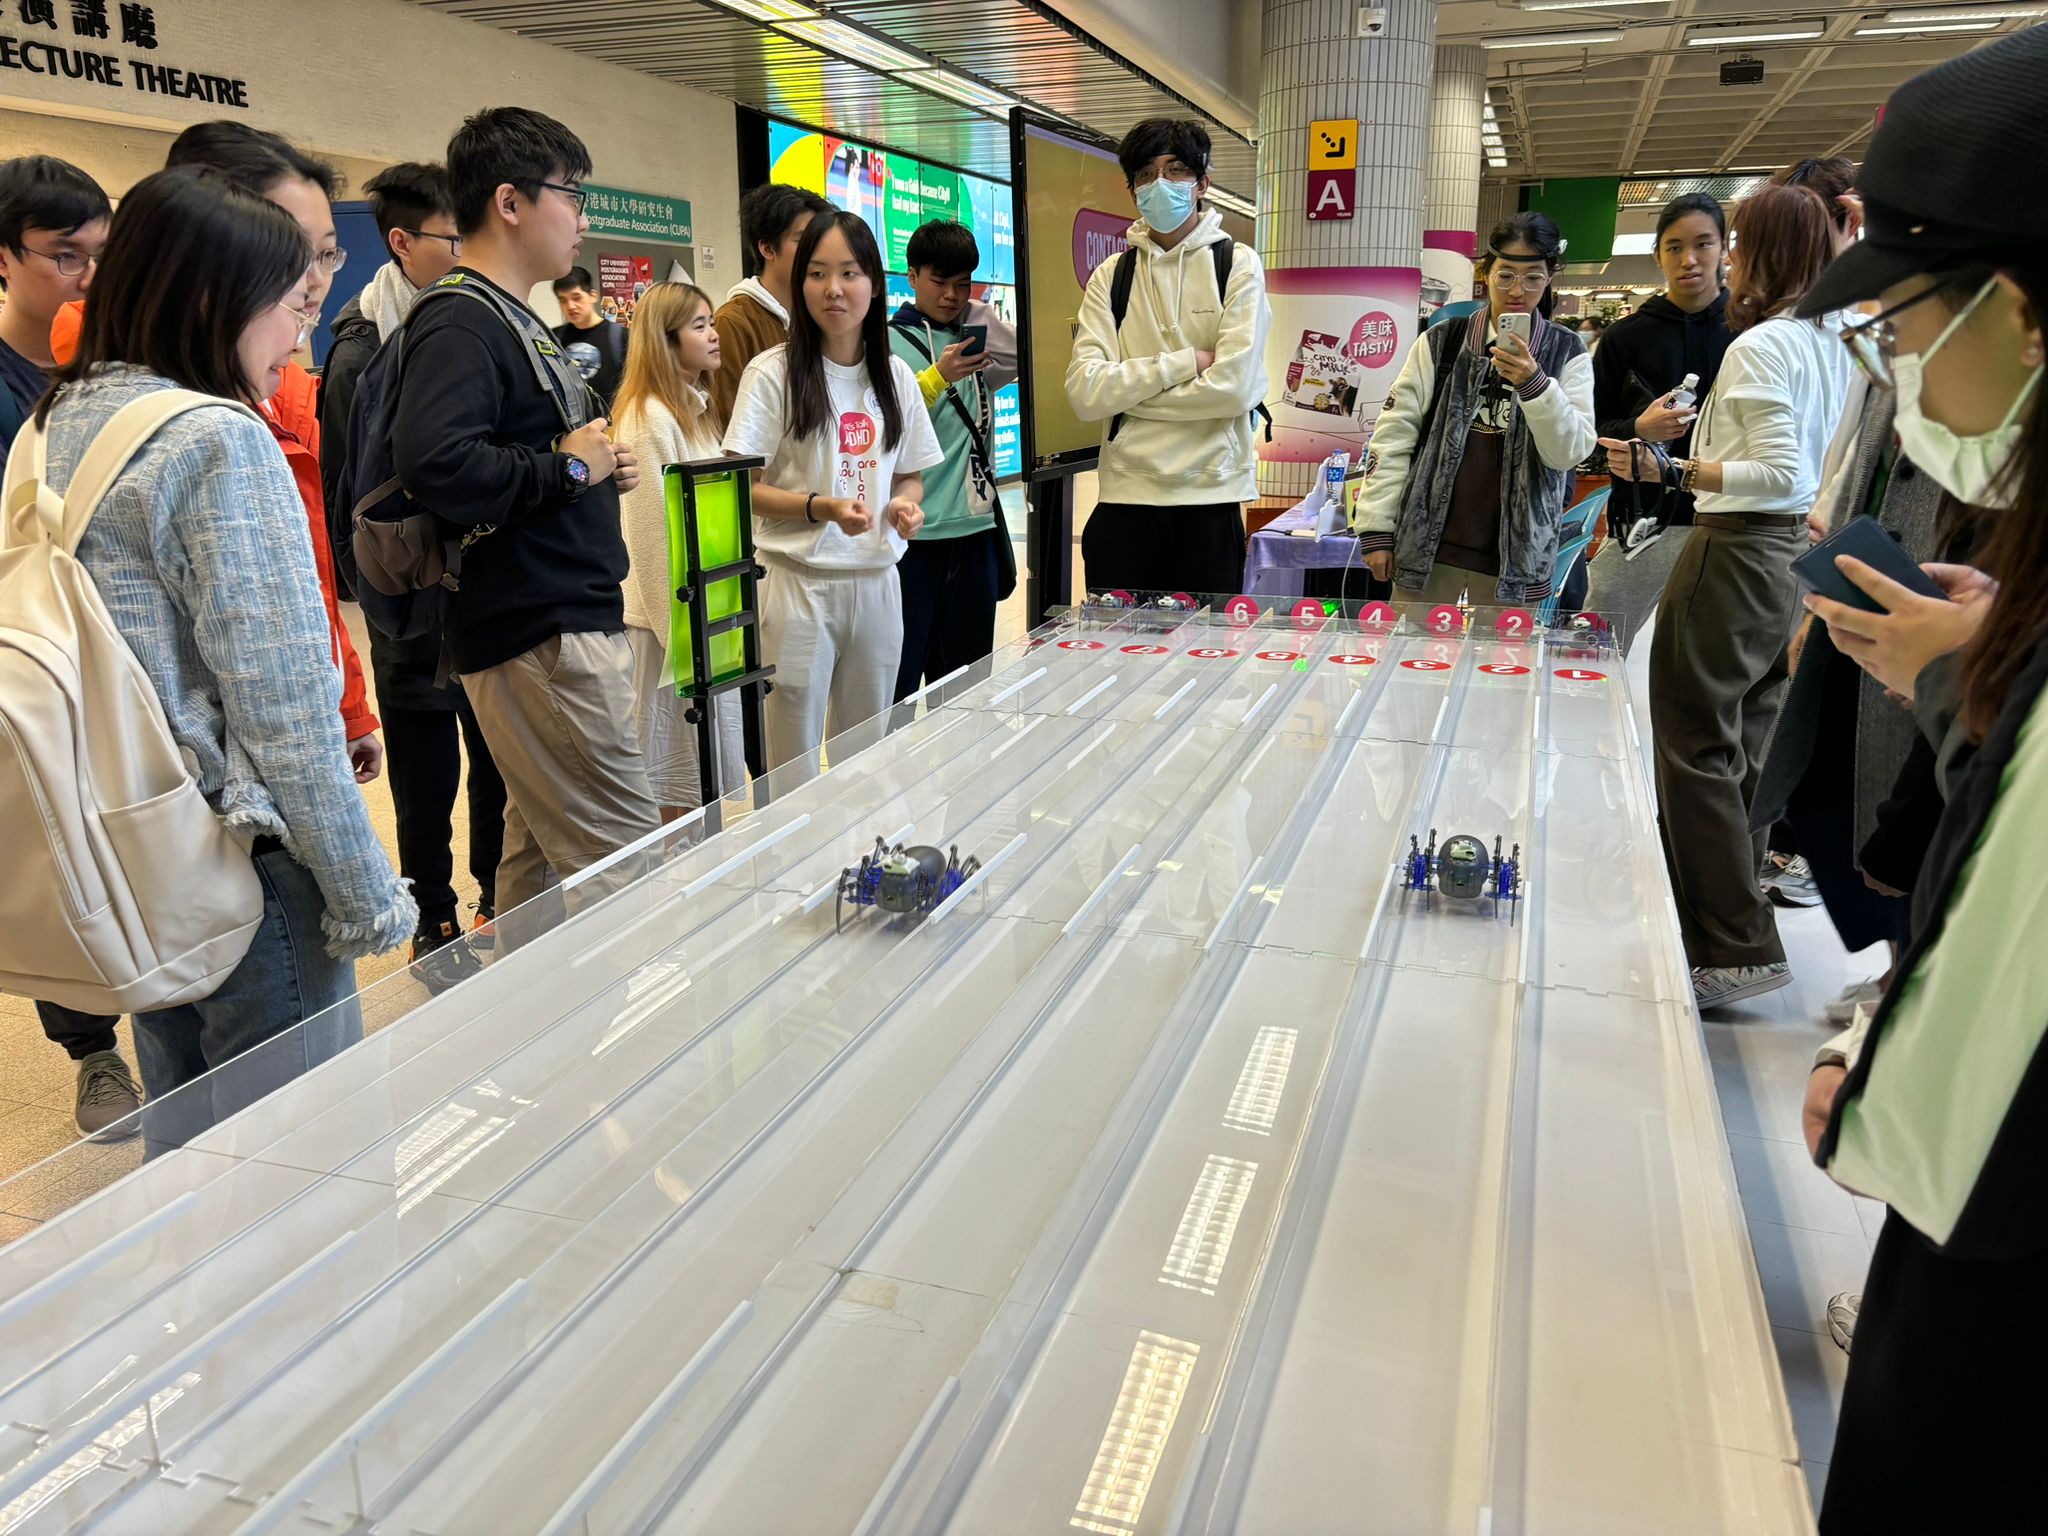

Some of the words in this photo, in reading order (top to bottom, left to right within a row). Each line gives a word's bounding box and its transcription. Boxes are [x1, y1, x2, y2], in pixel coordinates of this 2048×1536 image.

[129, 60, 249, 108] THEATRE
[1316, 180, 1345, 211] A
[587, 213, 631, 229] ostgraduate
[632, 219, 668, 235] Association
[670, 223, 691, 238] (CUPA)
[1086, 231, 1129, 270] CONT
[1361, 319, 1393, 339] 美味
[1353, 339, 1393, 358] TASTY!
[844, 429, 870, 446] ADHD
[1233, 603, 1248, 622] 6
[1300, 606, 1315, 626] 5
[1367, 608, 1382, 628] 4
[1435, 611, 1452, 632] 3
[1506, 616, 1522, 636] 2
